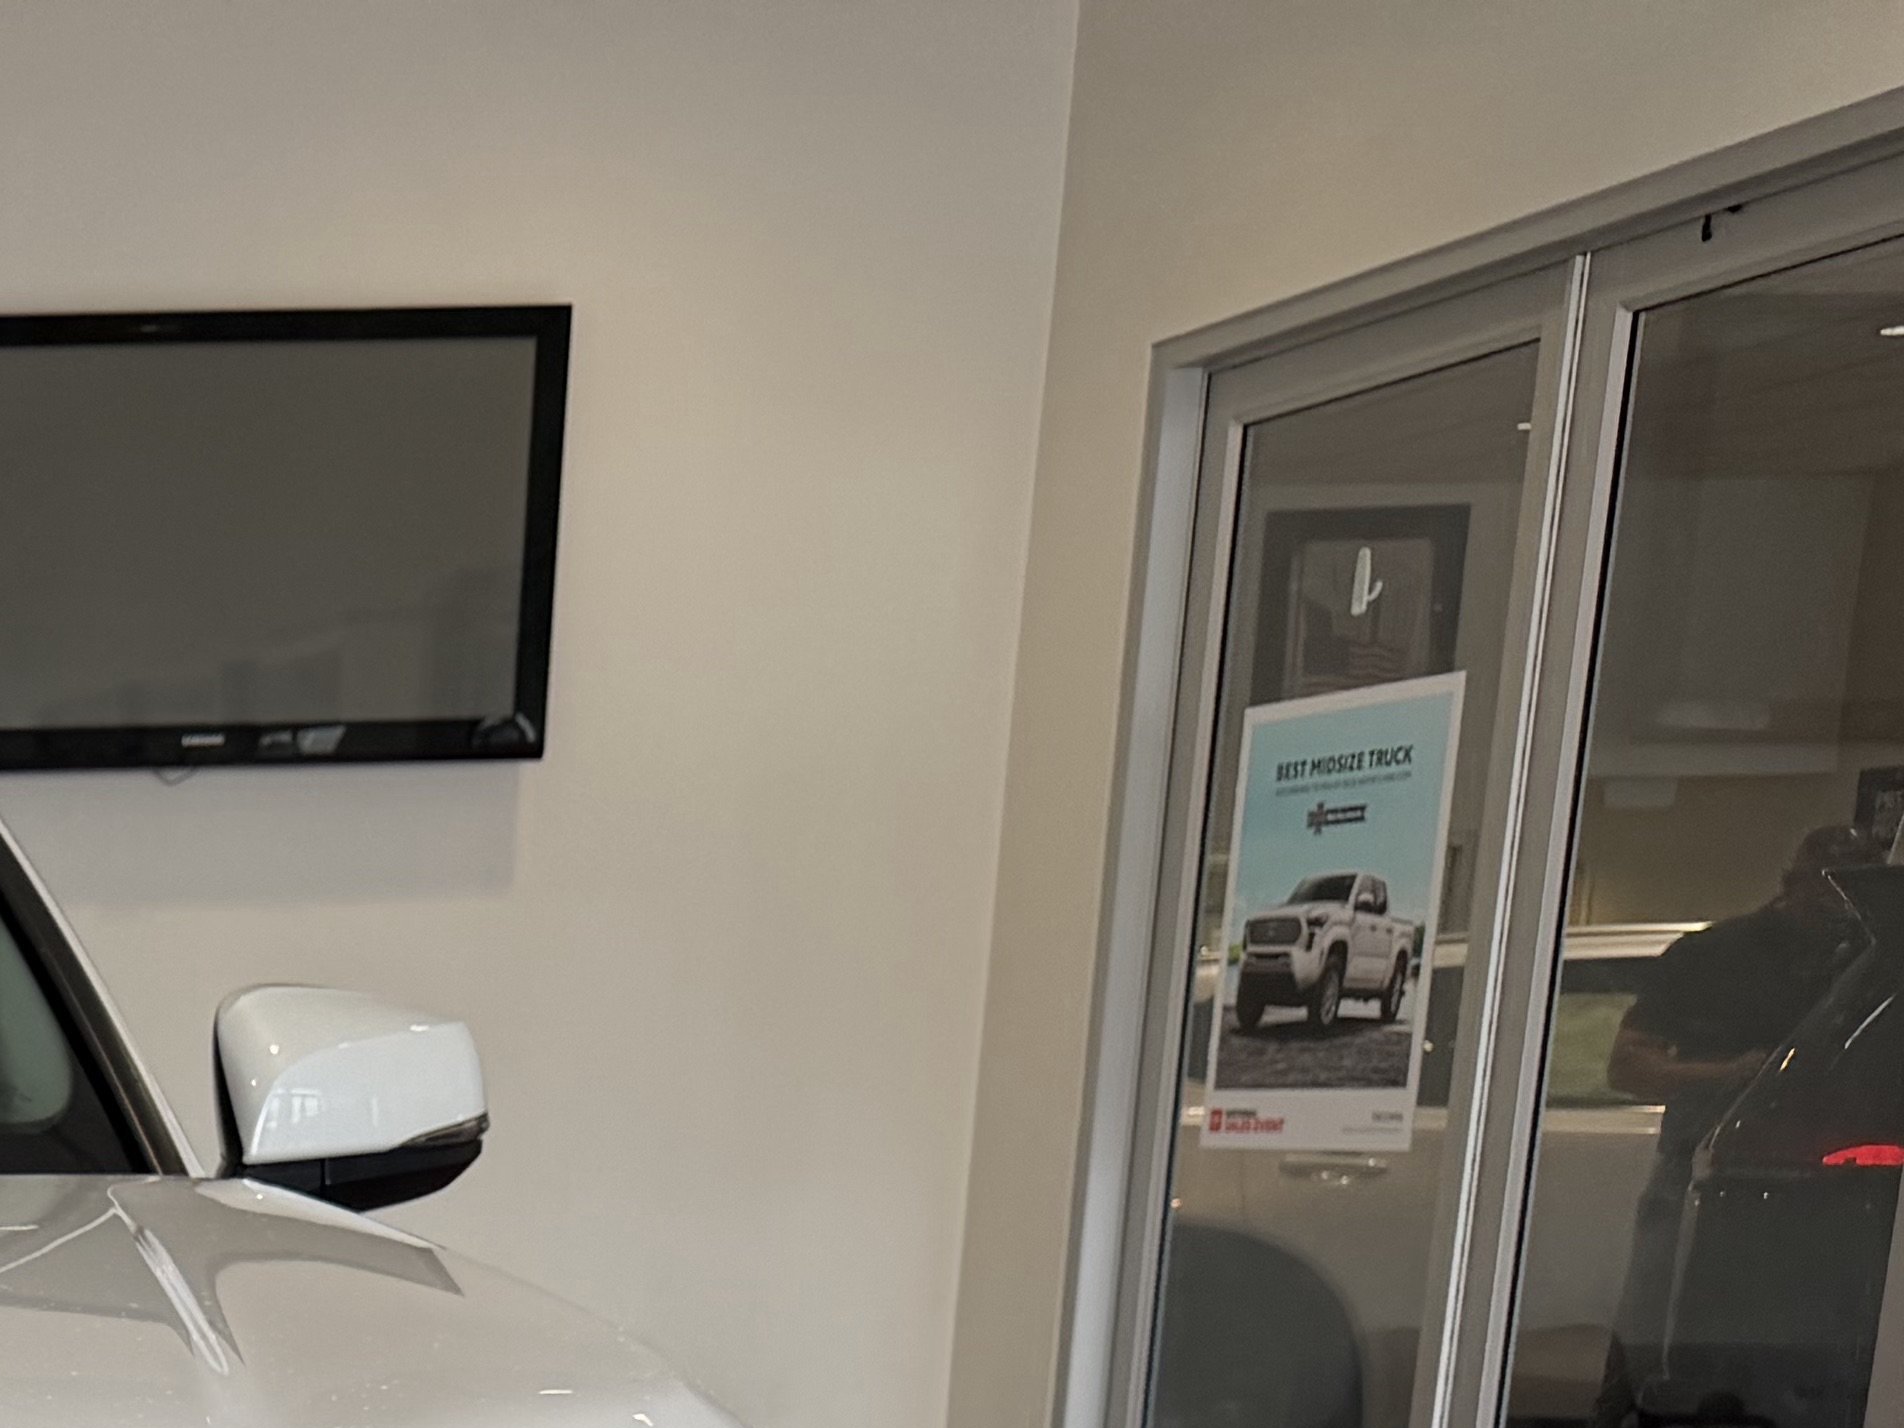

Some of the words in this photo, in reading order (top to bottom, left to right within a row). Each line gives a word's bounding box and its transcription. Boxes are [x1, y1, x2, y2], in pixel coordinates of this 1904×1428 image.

[1275, 759, 1309, 782] BEST
[1309, 751, 1366, 777] MIDSIZE
[1367, 744, 1414, 769] TRUCK
